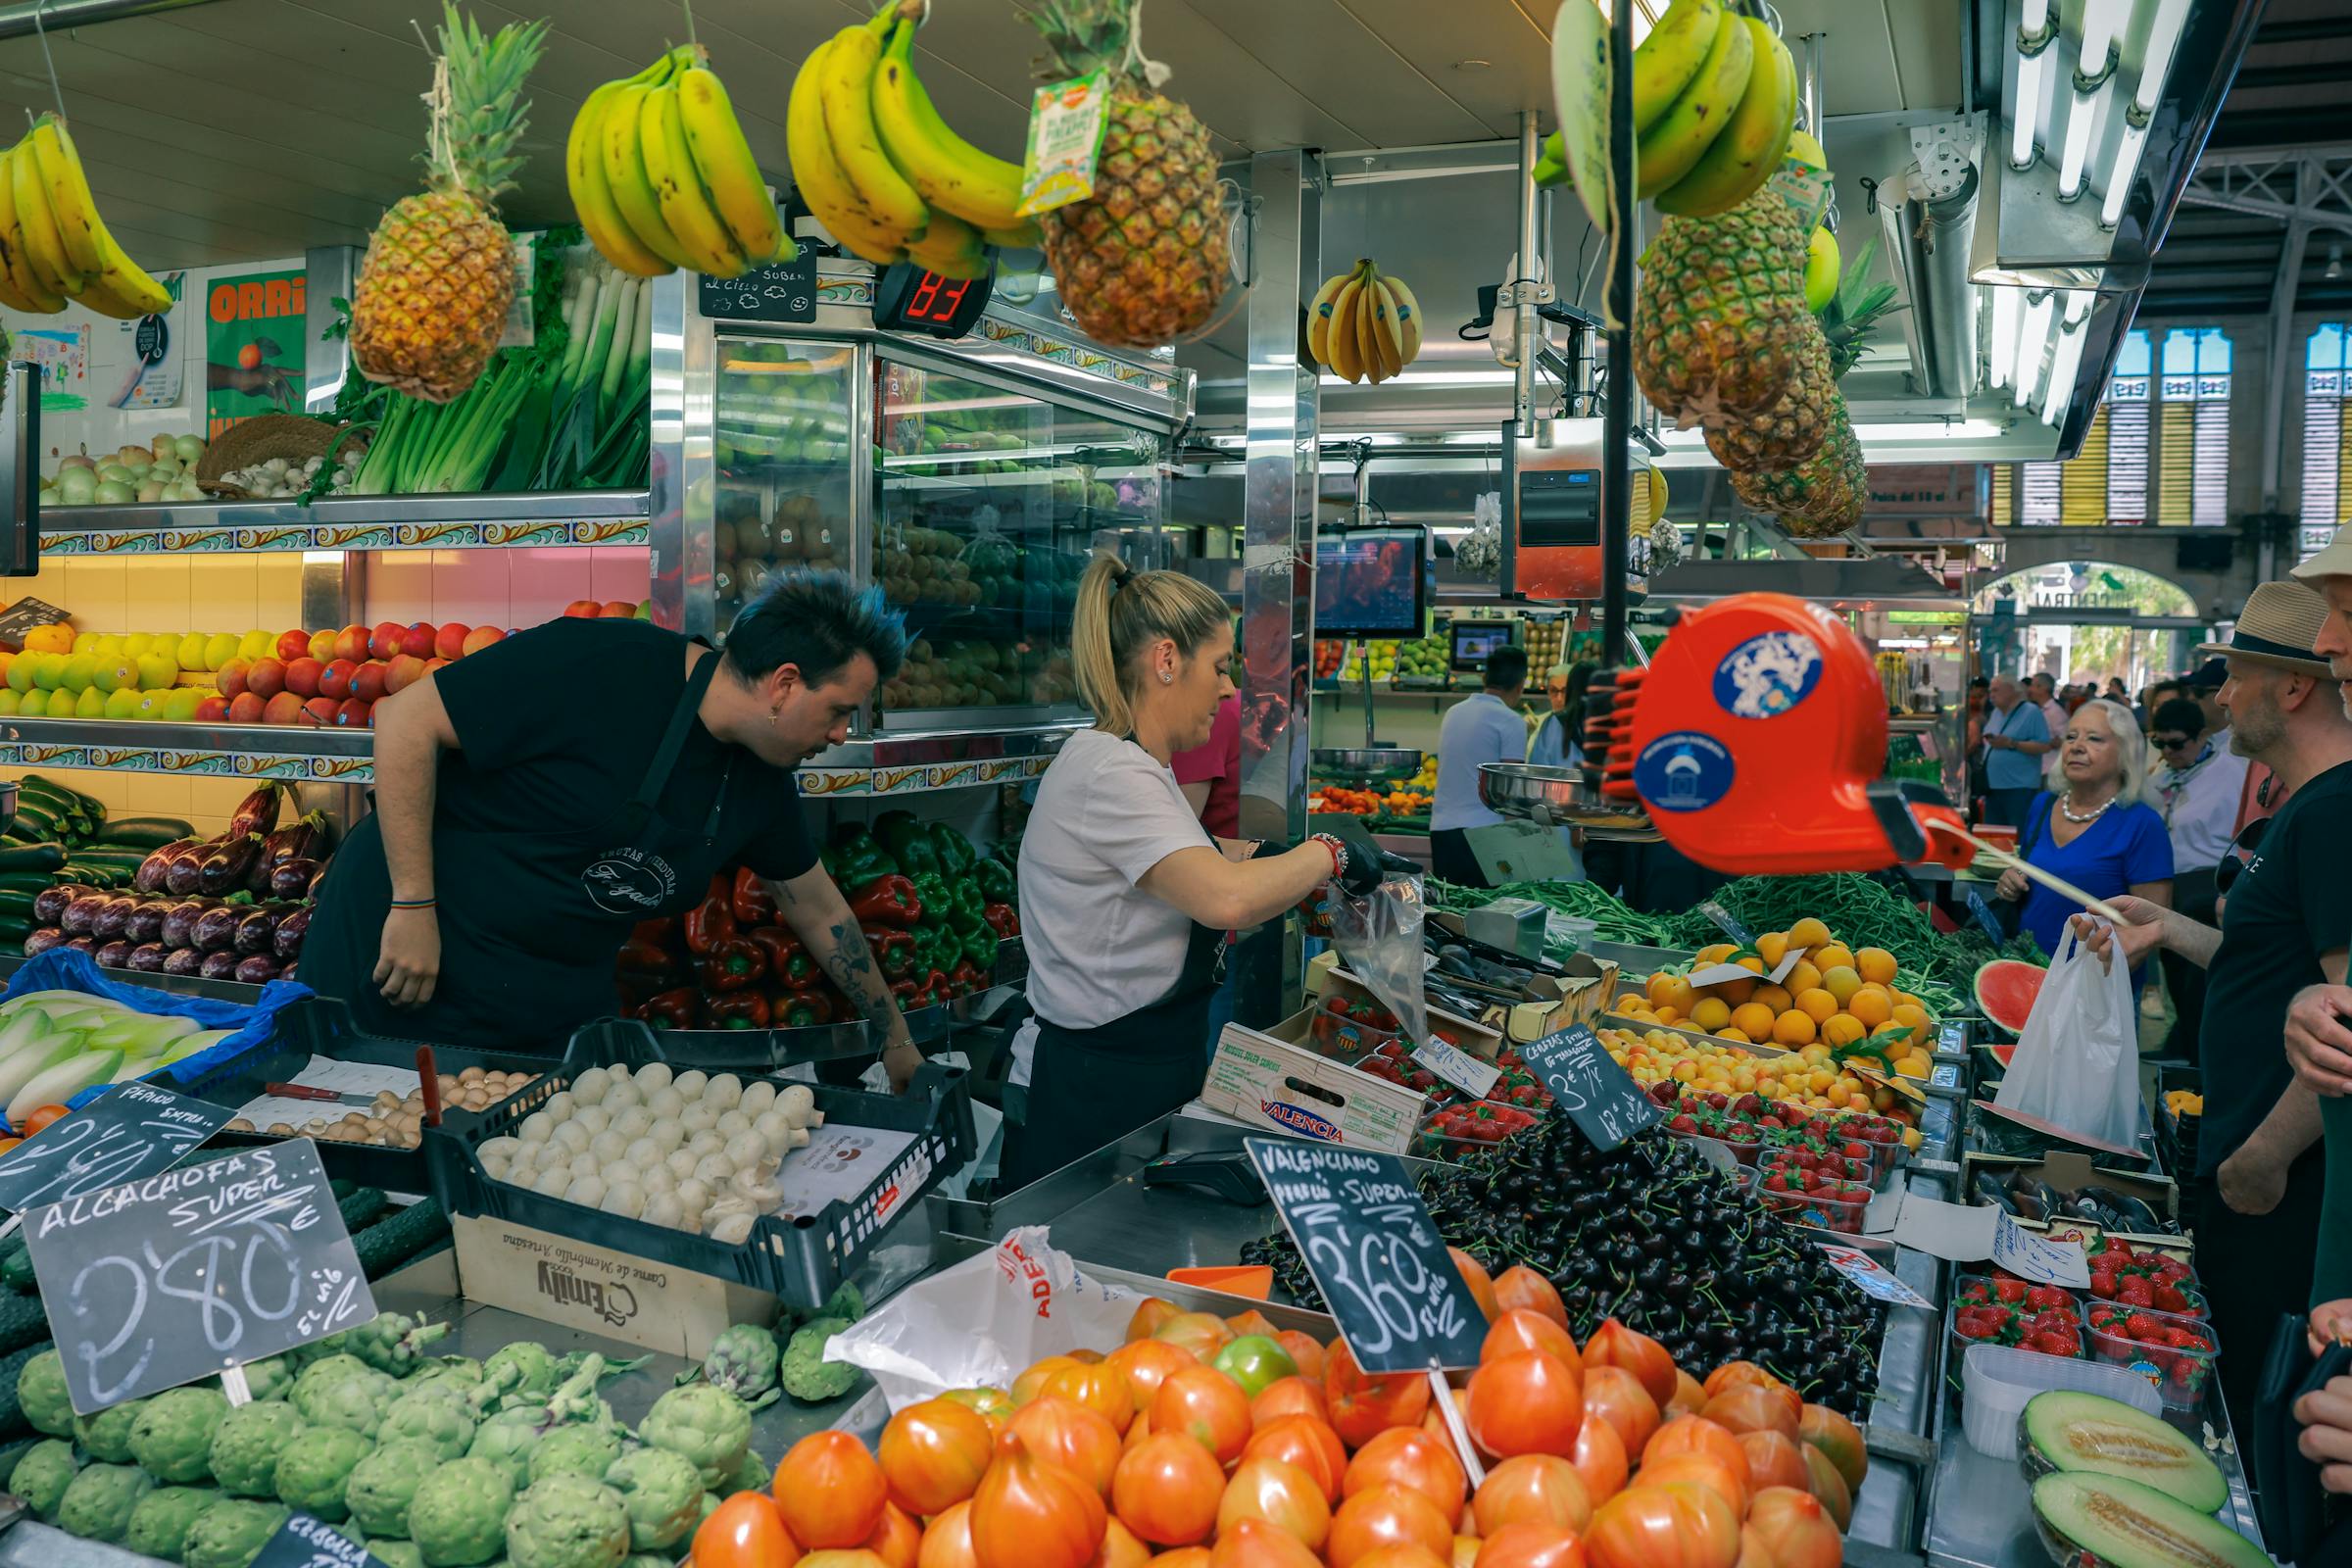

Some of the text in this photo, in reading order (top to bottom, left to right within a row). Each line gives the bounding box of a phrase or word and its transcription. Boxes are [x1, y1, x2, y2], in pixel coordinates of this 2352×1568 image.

[119, 1086, 176, 1105] PEPINO
[1260, 1098, 1344, 1145] VALENCIA
[1262, 1145, 1380, 1174] VALENCIANO
[38, 1150, 276, 1240] ALCACHOFAS
[555, 1248, 613, 1274] Membrillo
[616, 1263, 630, 1279] de
[537, 1259, 607, 1315] Emily
[633, 1269, 667, 1289] Carne
